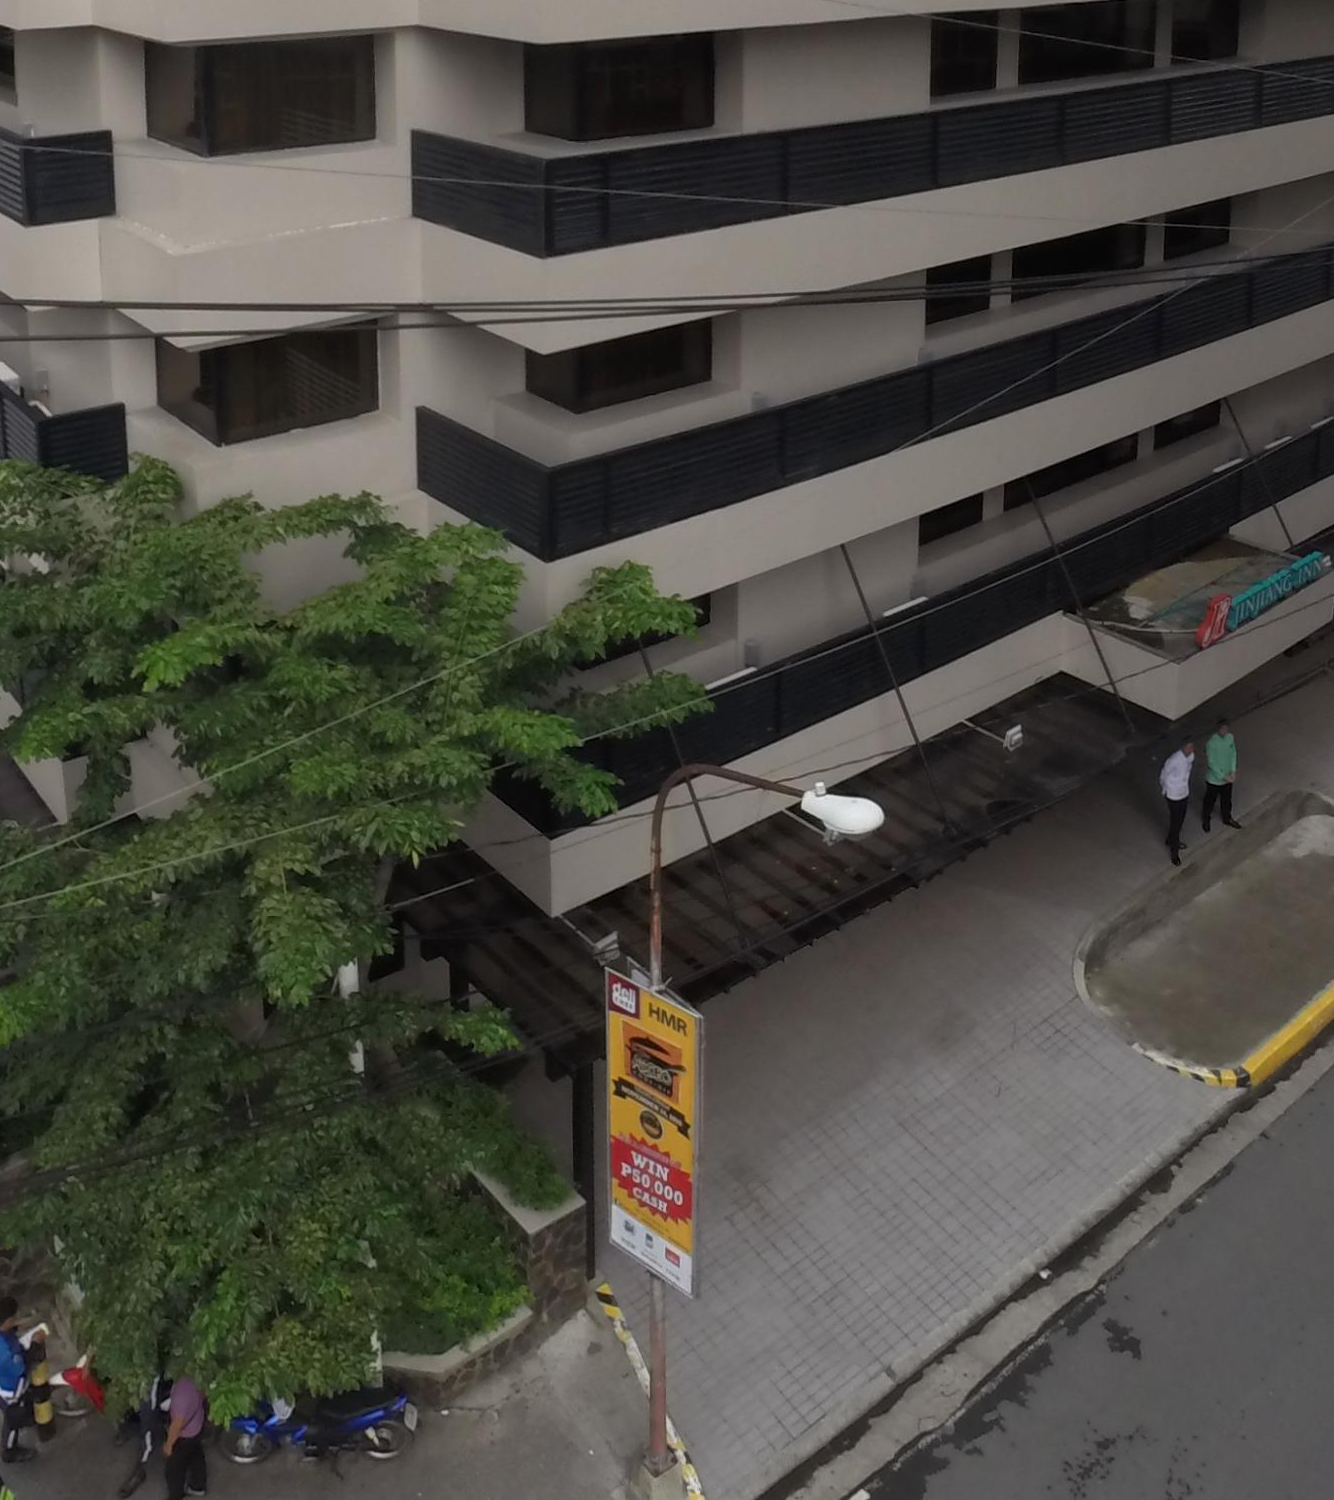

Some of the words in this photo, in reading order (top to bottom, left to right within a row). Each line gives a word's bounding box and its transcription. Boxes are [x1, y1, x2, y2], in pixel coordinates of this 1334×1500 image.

[1233, 573, 1293, 629] JINJIANG
[1297, 558, 1324, 587] INN
[648, 1002, 688, 1037] HMR
[630, 1150, 670, 1182] WIN
[632, 1186, 668, 1214] CASH
